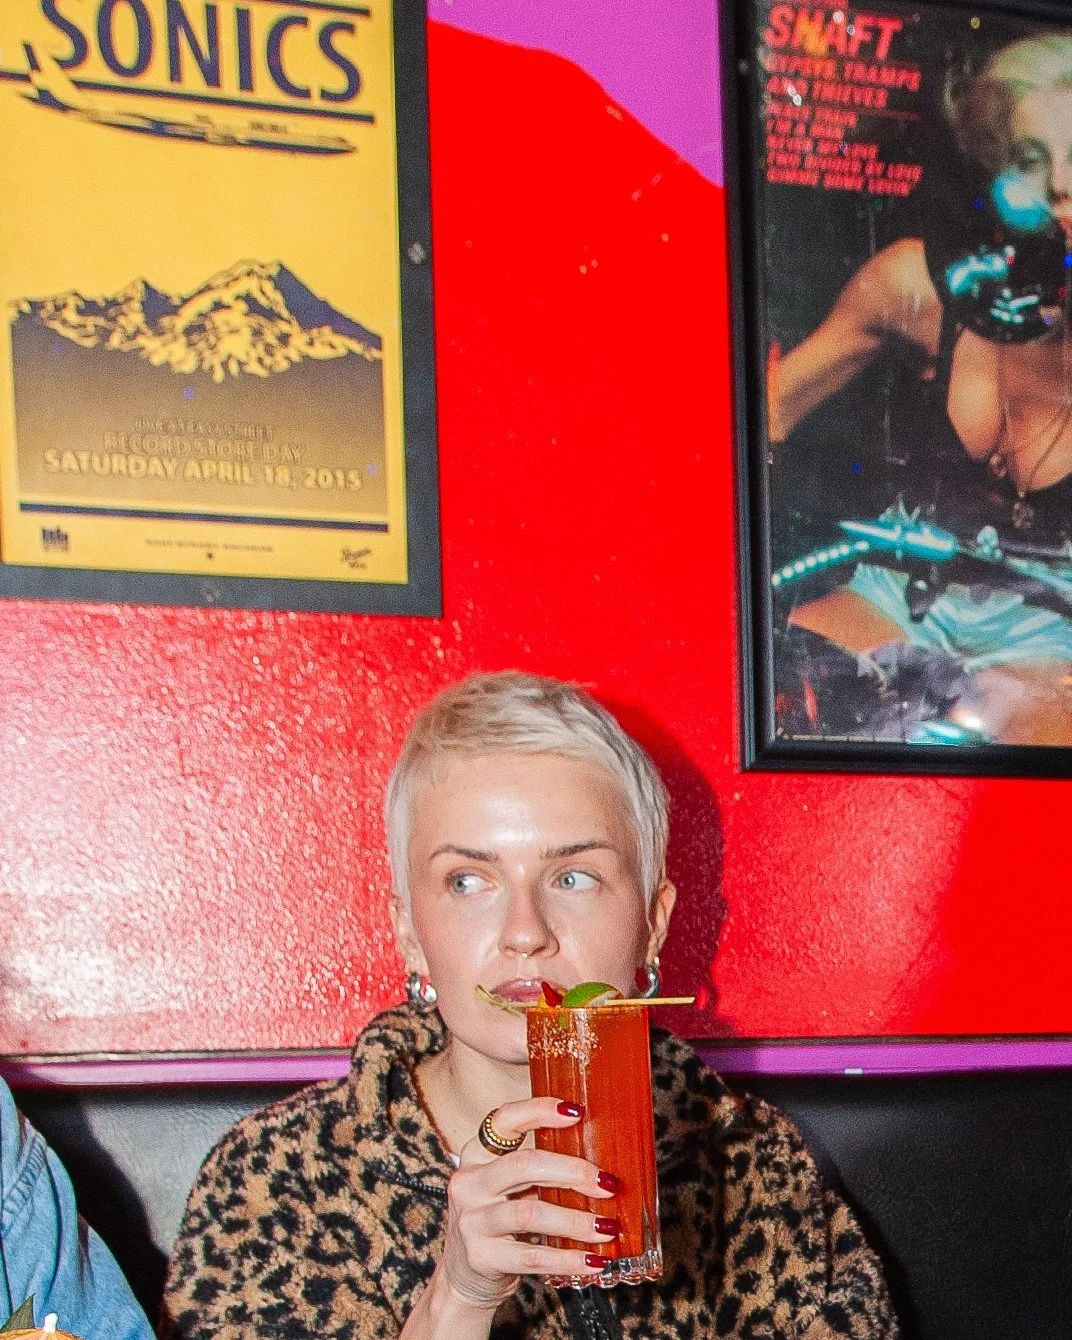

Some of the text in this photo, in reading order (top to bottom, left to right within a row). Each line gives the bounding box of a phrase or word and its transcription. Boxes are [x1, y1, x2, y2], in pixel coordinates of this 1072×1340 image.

[40, 0, 362, 103] SONICS
[763, 5, 902, 60] SHAFT
[43, 448, 363, 492] SATURDAY APRIL 18, 2015
[262, 442, 304, 466] DAY
